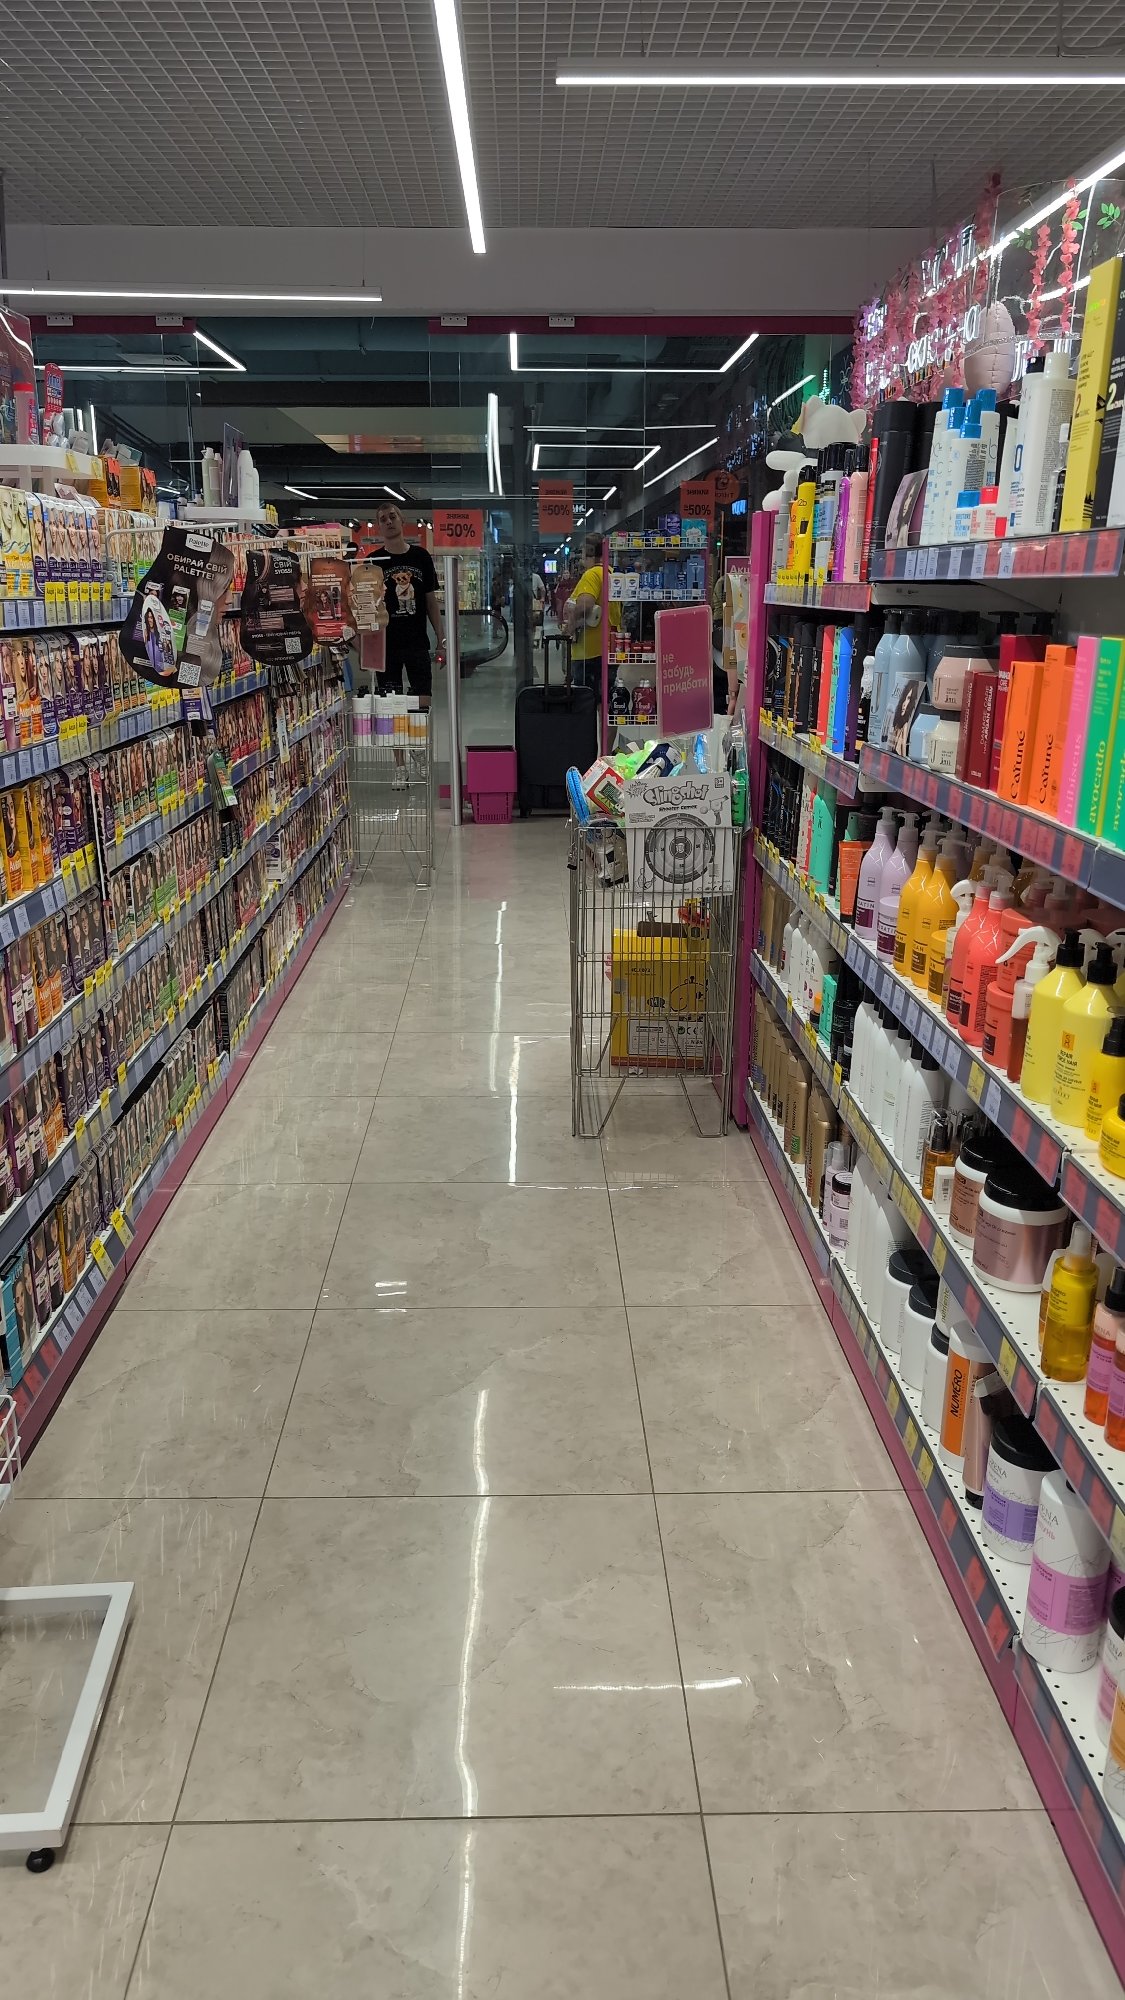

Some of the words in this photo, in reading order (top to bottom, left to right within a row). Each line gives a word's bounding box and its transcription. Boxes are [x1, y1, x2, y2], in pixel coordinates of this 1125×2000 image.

[167, 553, 204, 568] ОБИРАЙ
[205, 562, 228, 574] СВІЙ
[174, 564, 216, 580] PALETTE!
[662, 664, 695, 680] забудь
[1089, 740, 1107, 824] avocado
[950, 1369, 963, 1418] NUMÉRO
